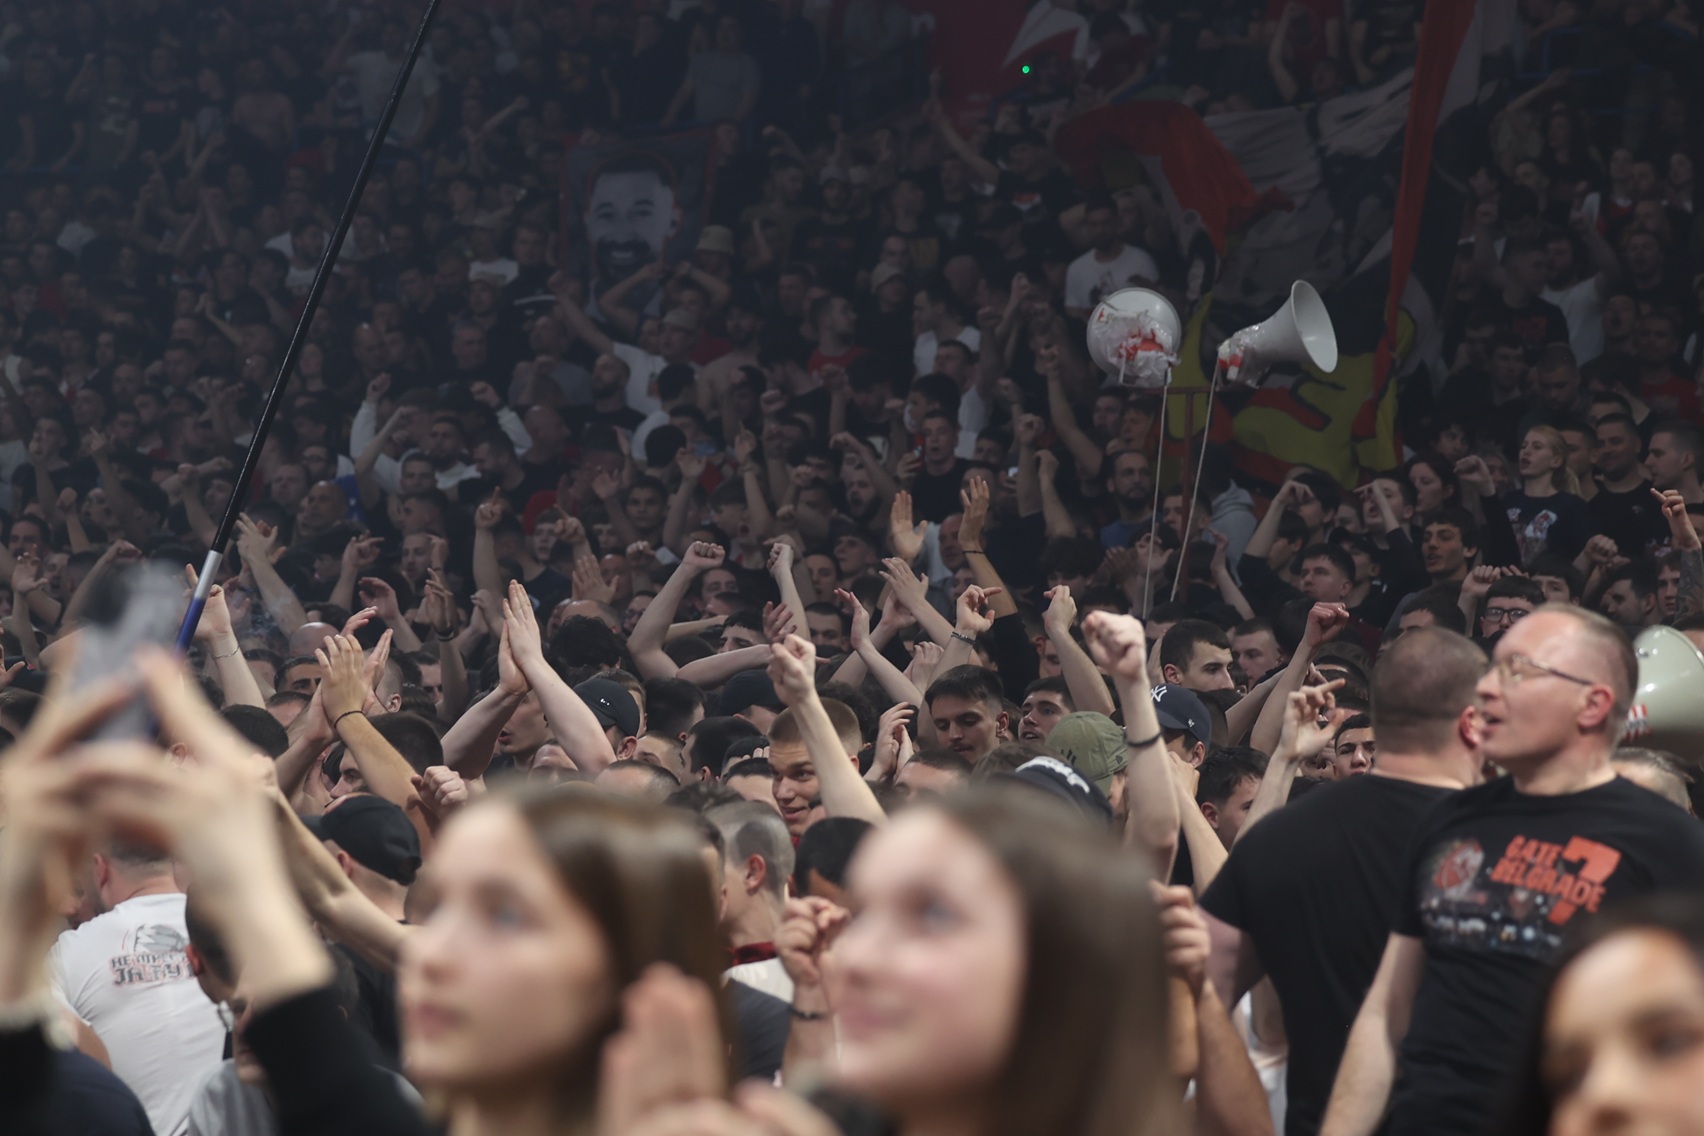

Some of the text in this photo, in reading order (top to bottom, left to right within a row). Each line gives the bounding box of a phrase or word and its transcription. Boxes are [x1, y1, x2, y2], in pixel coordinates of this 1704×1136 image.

[1490, 856, 1606, 913] BELGRADE
[1505, 834, 1621, 926] GATE 7
